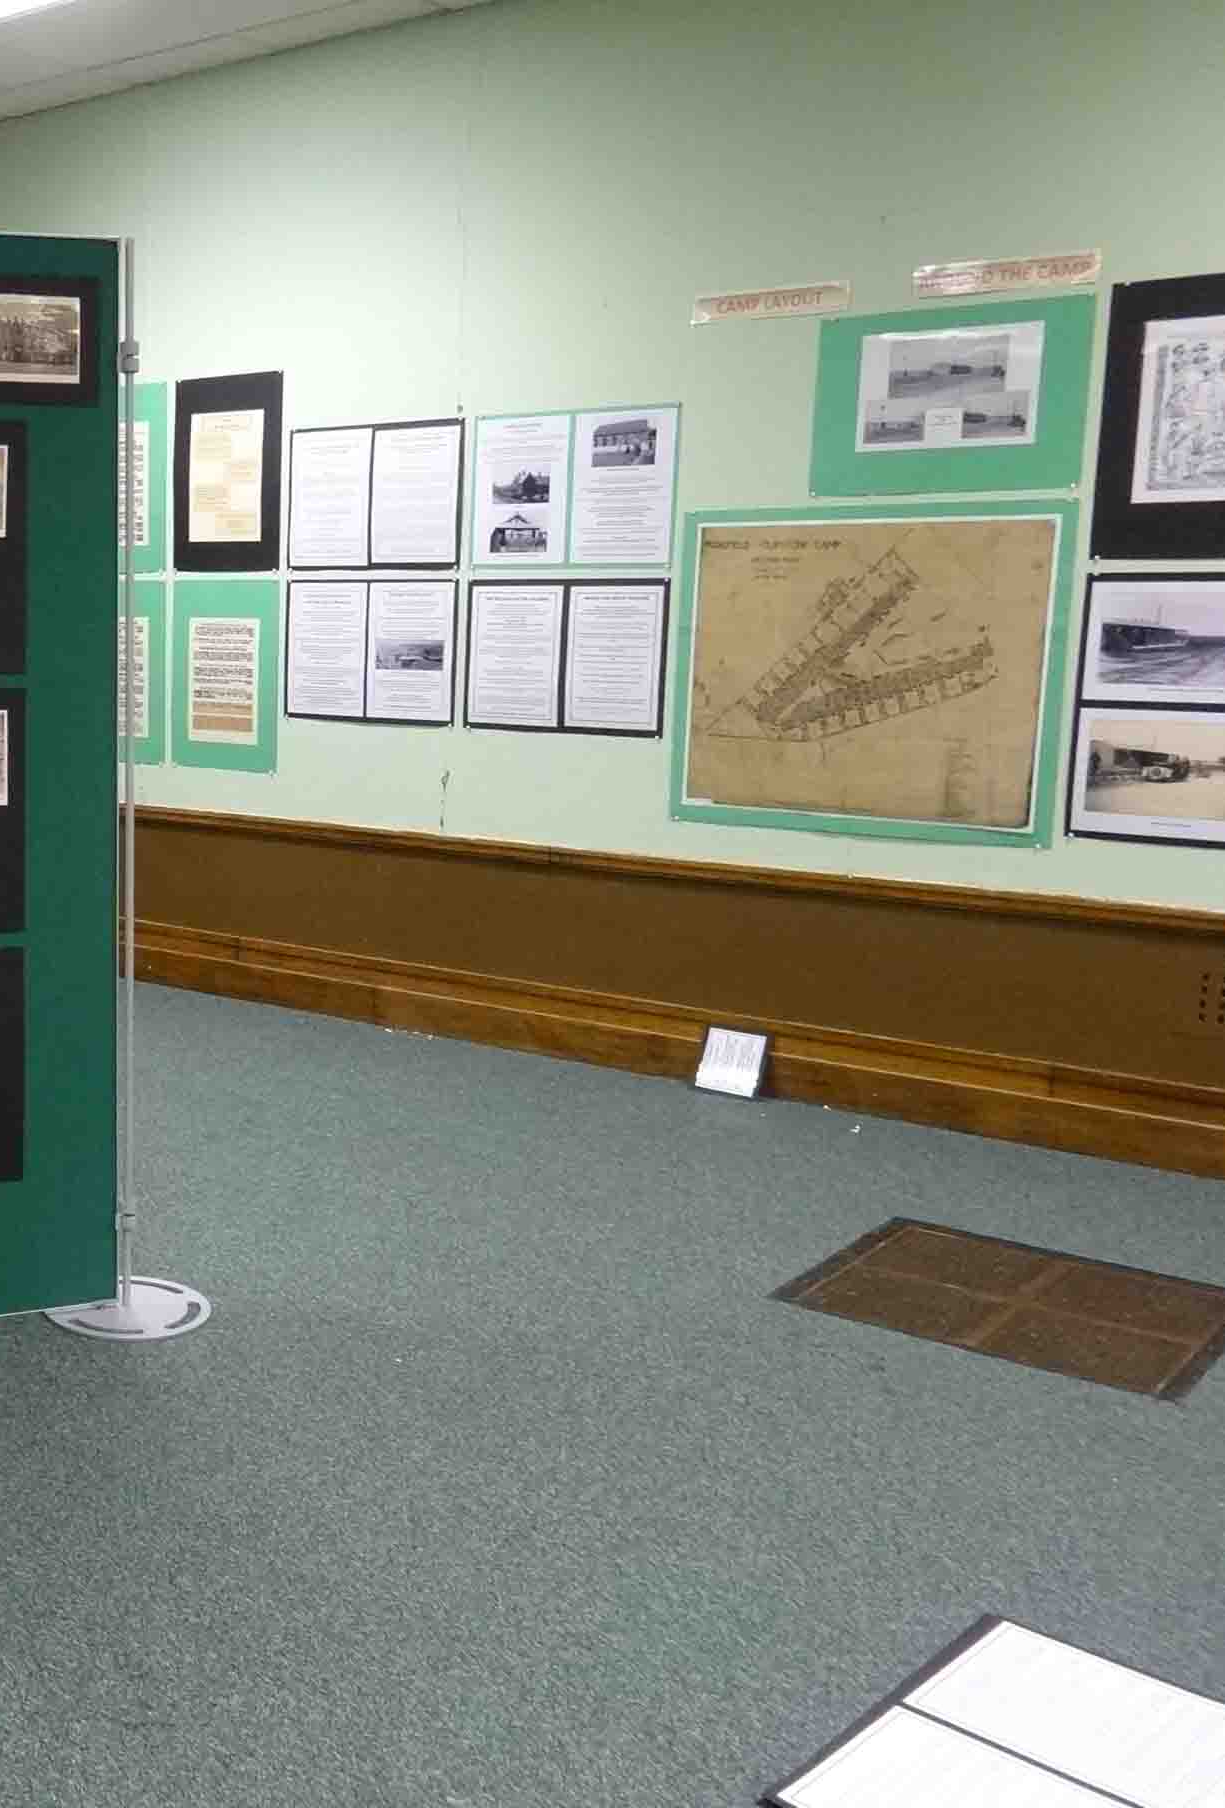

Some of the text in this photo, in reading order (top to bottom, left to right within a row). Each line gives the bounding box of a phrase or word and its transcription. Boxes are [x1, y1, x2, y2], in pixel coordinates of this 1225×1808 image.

[998, 264, 1033, 281] THE
[1037, 260, 1092, 279] CAMP
[717, 291, 823, 313] CAMP LAYOUT
